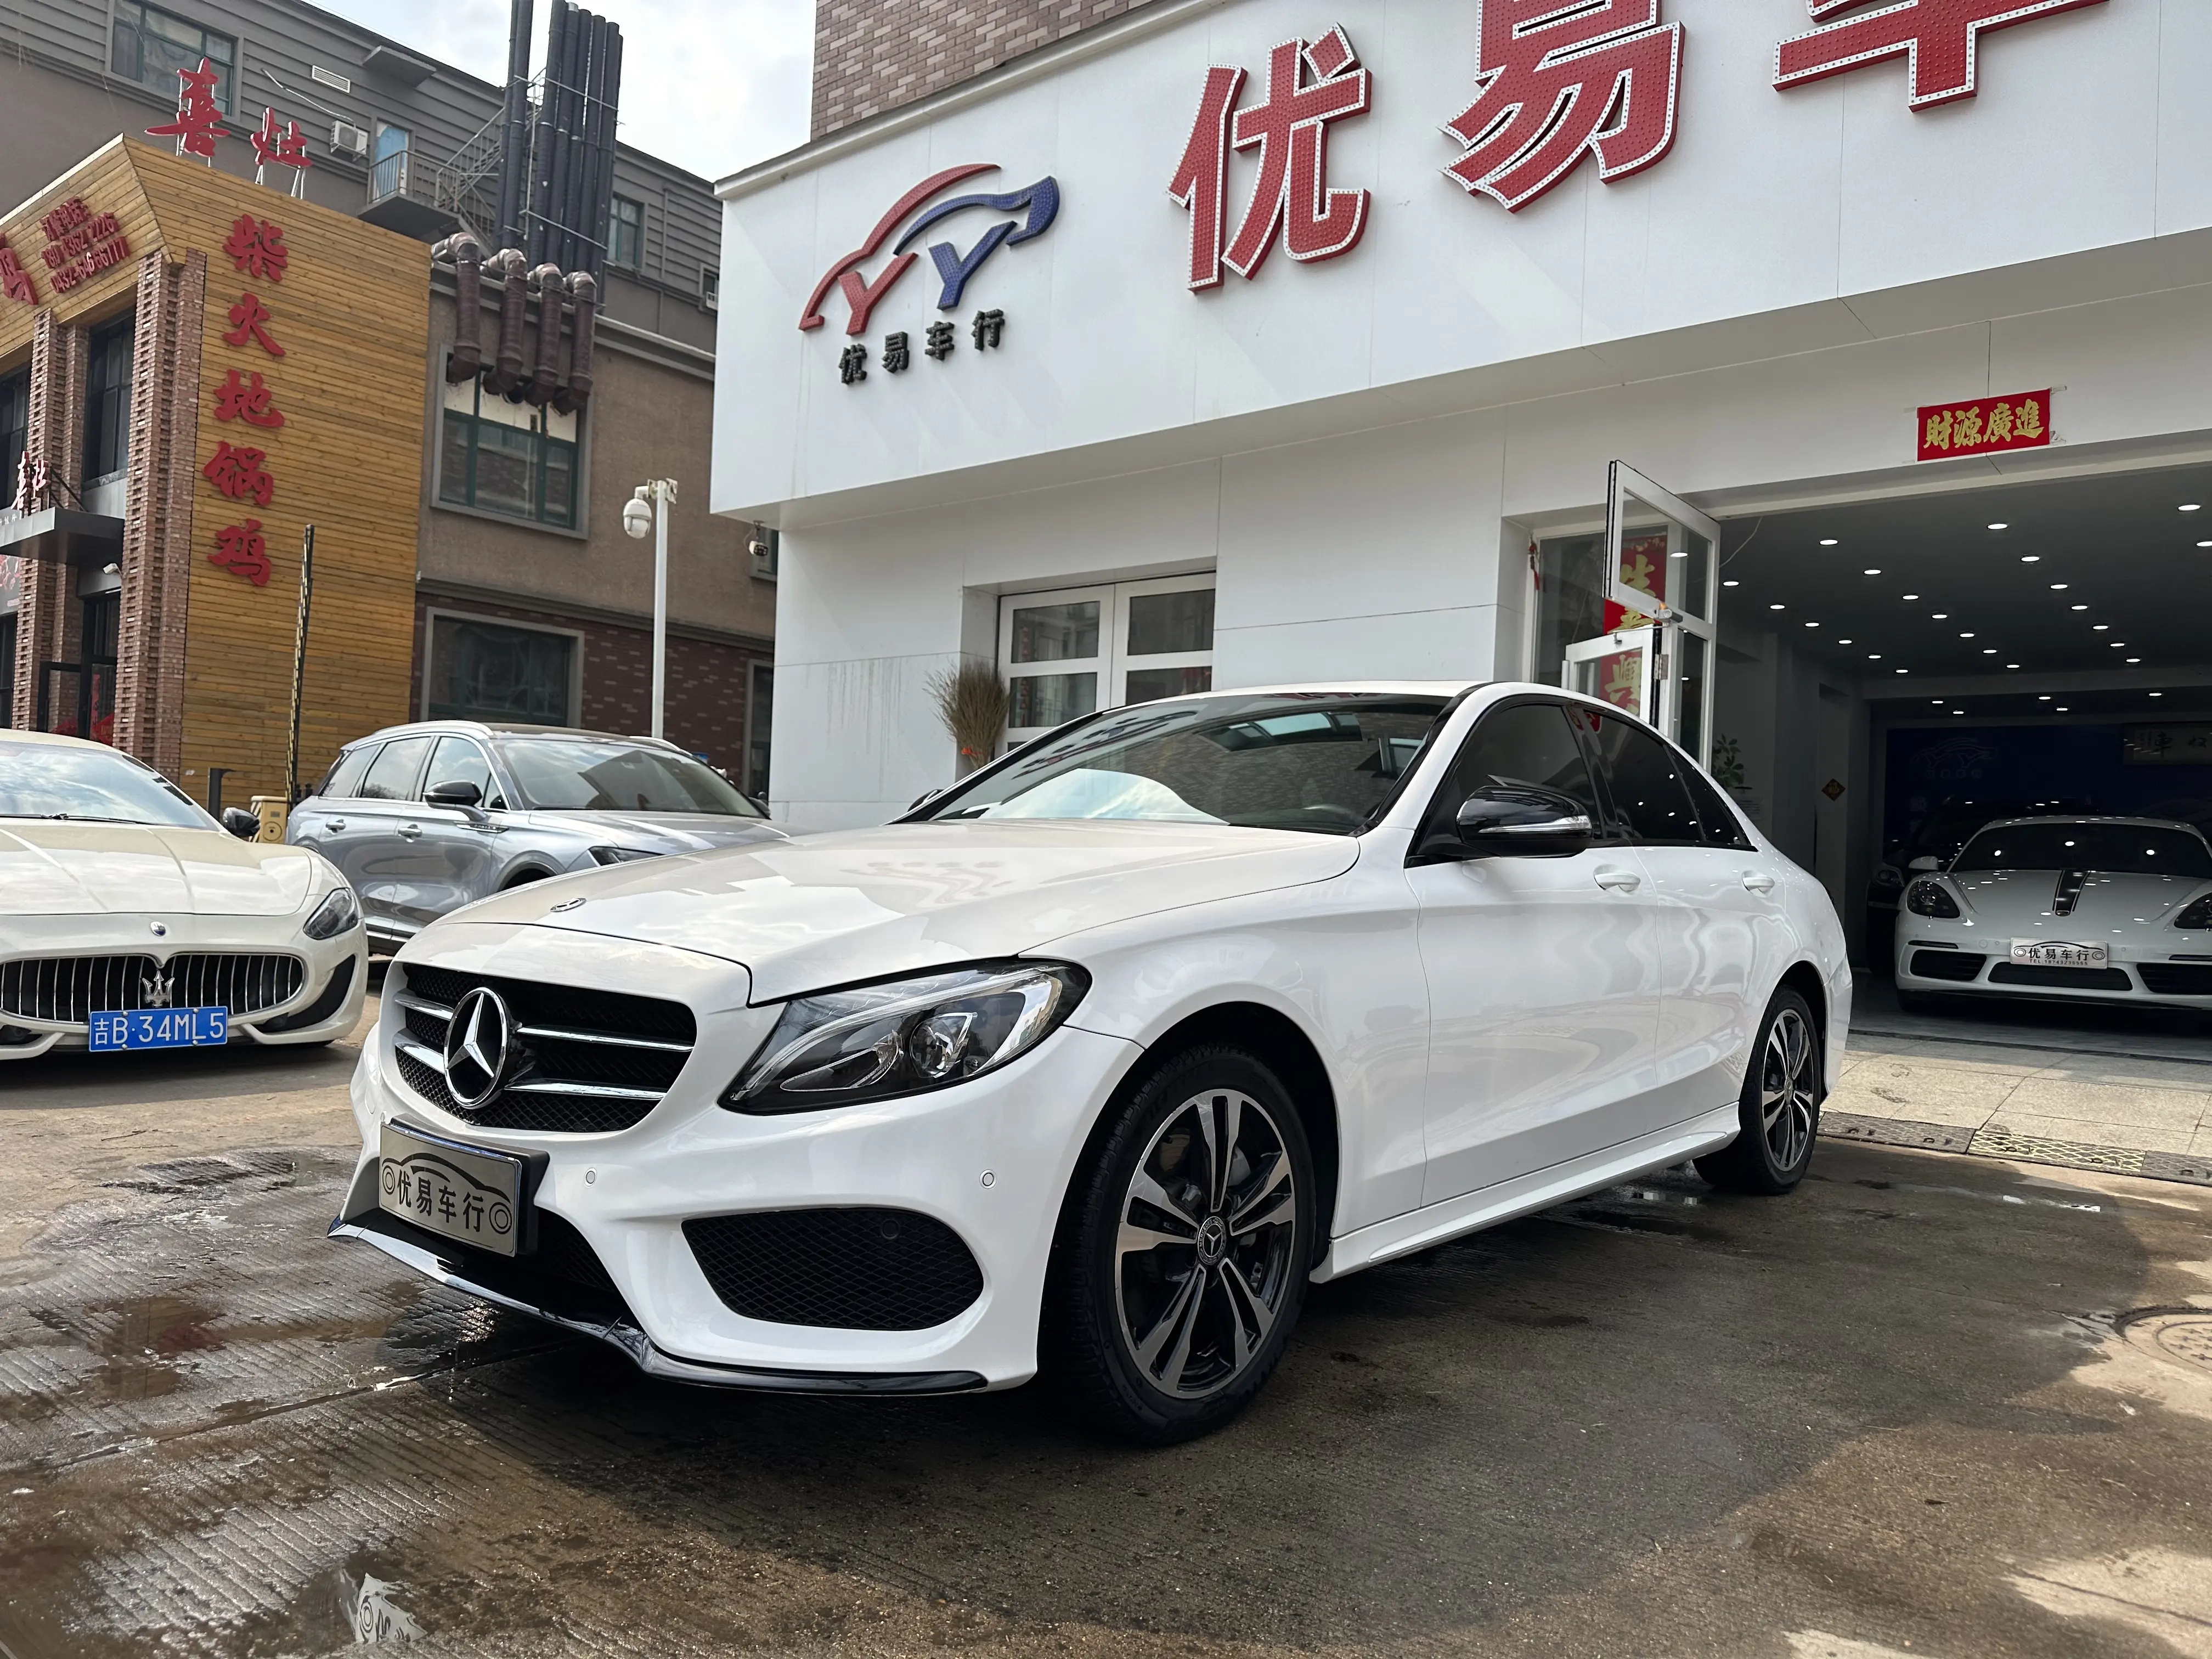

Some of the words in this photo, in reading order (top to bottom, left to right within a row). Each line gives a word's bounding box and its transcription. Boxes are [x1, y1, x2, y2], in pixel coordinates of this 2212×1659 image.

[838, 308, 1005, 385] 优易车行
[203, 214, 289, 586] 柴火地锅鸡
[1923, 398, 2045, 450] 財源廣進
[2028, 947, 2090, 961] 优易车行
[397, 1169, 485, 1233] 优易车行
